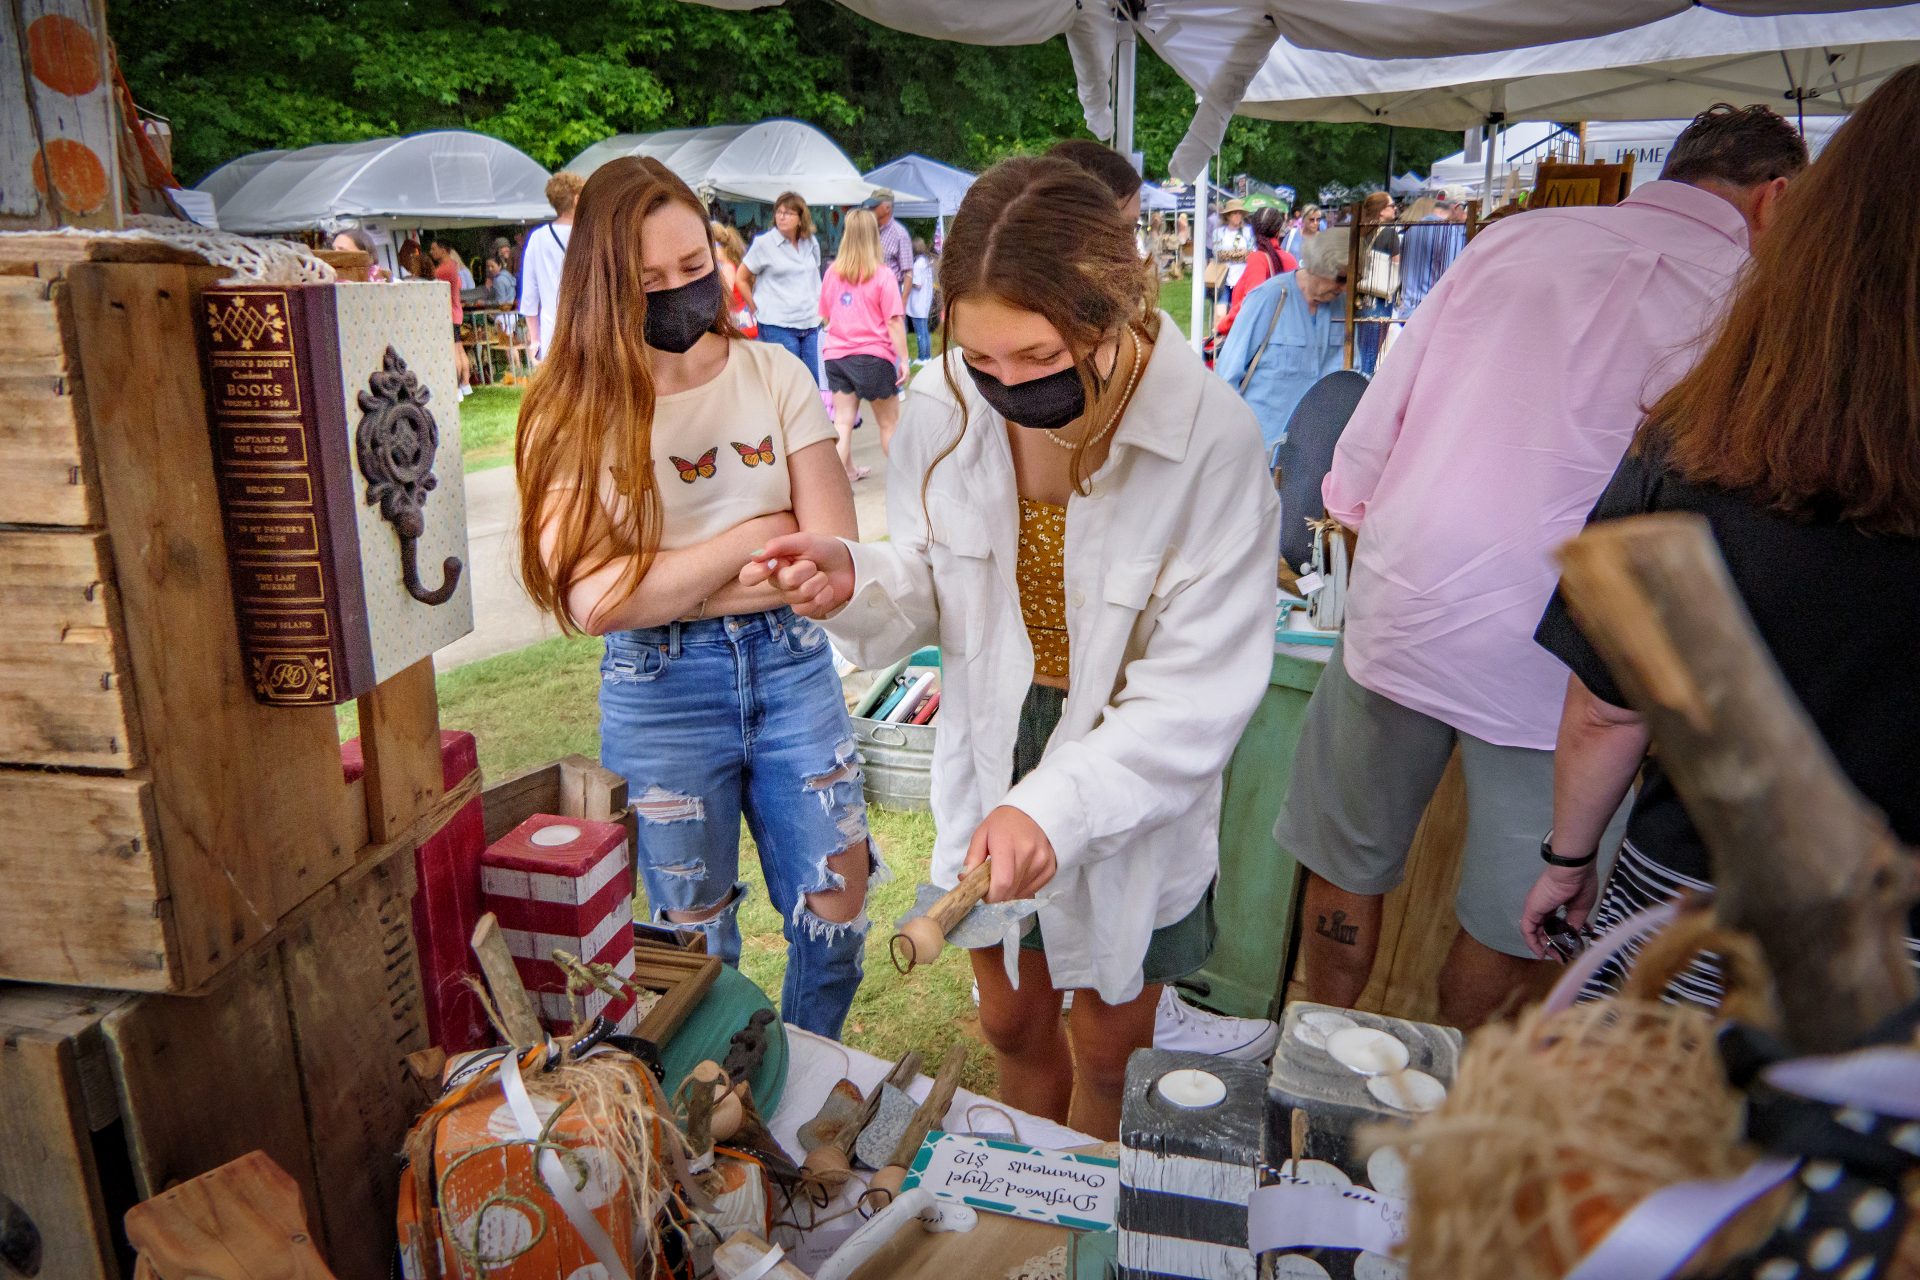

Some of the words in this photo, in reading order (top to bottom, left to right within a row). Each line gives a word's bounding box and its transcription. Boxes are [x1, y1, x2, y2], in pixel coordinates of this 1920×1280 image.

[1616, 147, 1664, 163] HOME
[256, 359, 290, 368] DIGEST
[226, 383, 283, 397] BOOKS
[233, 436, 271, 444] CAPTAIN
[272, 436, 287, 444] OF
[233, 446, 252, 454] THE
[953, 1150, 989, 1169] $12
[945, 1169, 1004, 1193] Angel
[1008, 1160, 1106, 1188] Ornaments
[1004, 1181, 1099, 1212] Driftwood
